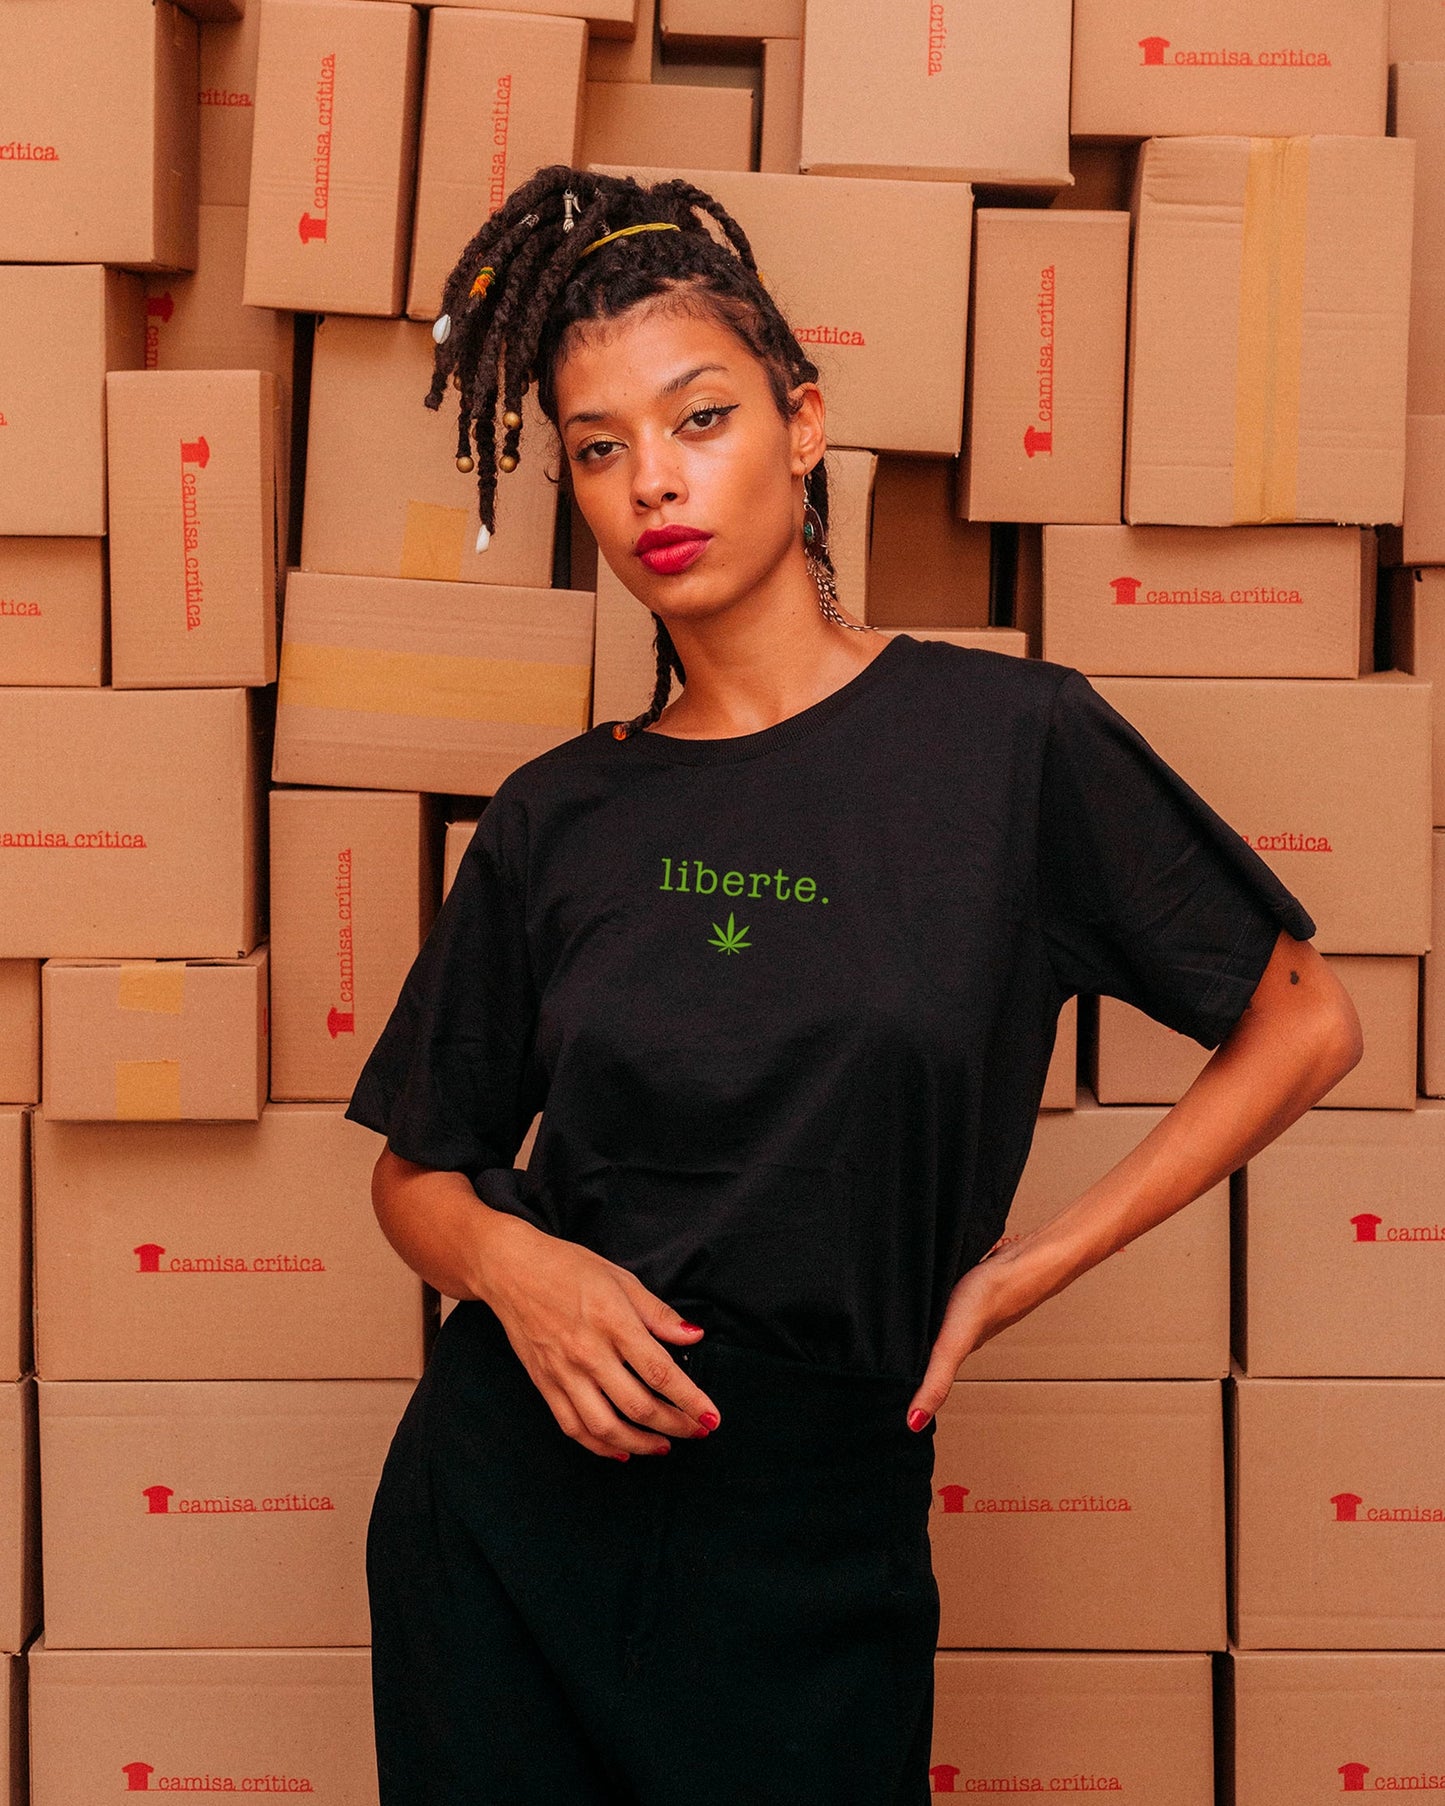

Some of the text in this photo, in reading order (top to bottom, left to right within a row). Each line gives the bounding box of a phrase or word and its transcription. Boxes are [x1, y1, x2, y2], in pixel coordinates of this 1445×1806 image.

[928, 4, 947, 76] crítica
[1174, 48, 1331, 67] camisa crítica
[198, 88, 252, 106] rítica
[492, 75, 512, 146] crítica
[314, 53, 335, 209] camisa crítica
[0, 142, 59, 161] rítica
[794, 325, 865, 346] crítica
[1037, 265, 1054, 422] camisa crítica
[144, 325, 159, 368] cam
[182, 473, 203, 630] camisa crítica
[1146, 587, 1303, 604] camisa crítica
[0, 599, 41, 616] tica
[0, 830, 147, 849] amisa crítica
[1257, 832, 1332, 852] crítica
[659, 858, 829, 904] liberte.
[335, 848, 353, 1003] camisa crítica
[170, 1255, 325, 1273] camisa crítica
[179, 1494, 335, 1513] camisa crítica
[974, 1495, 1131, 1513] camisa crítica
[1367, 1506, 1445, 1522] camisa
[159, 1775, 313, 1793] camisa crítica
[965, 1774, 1122, 1793] camisa crítica
